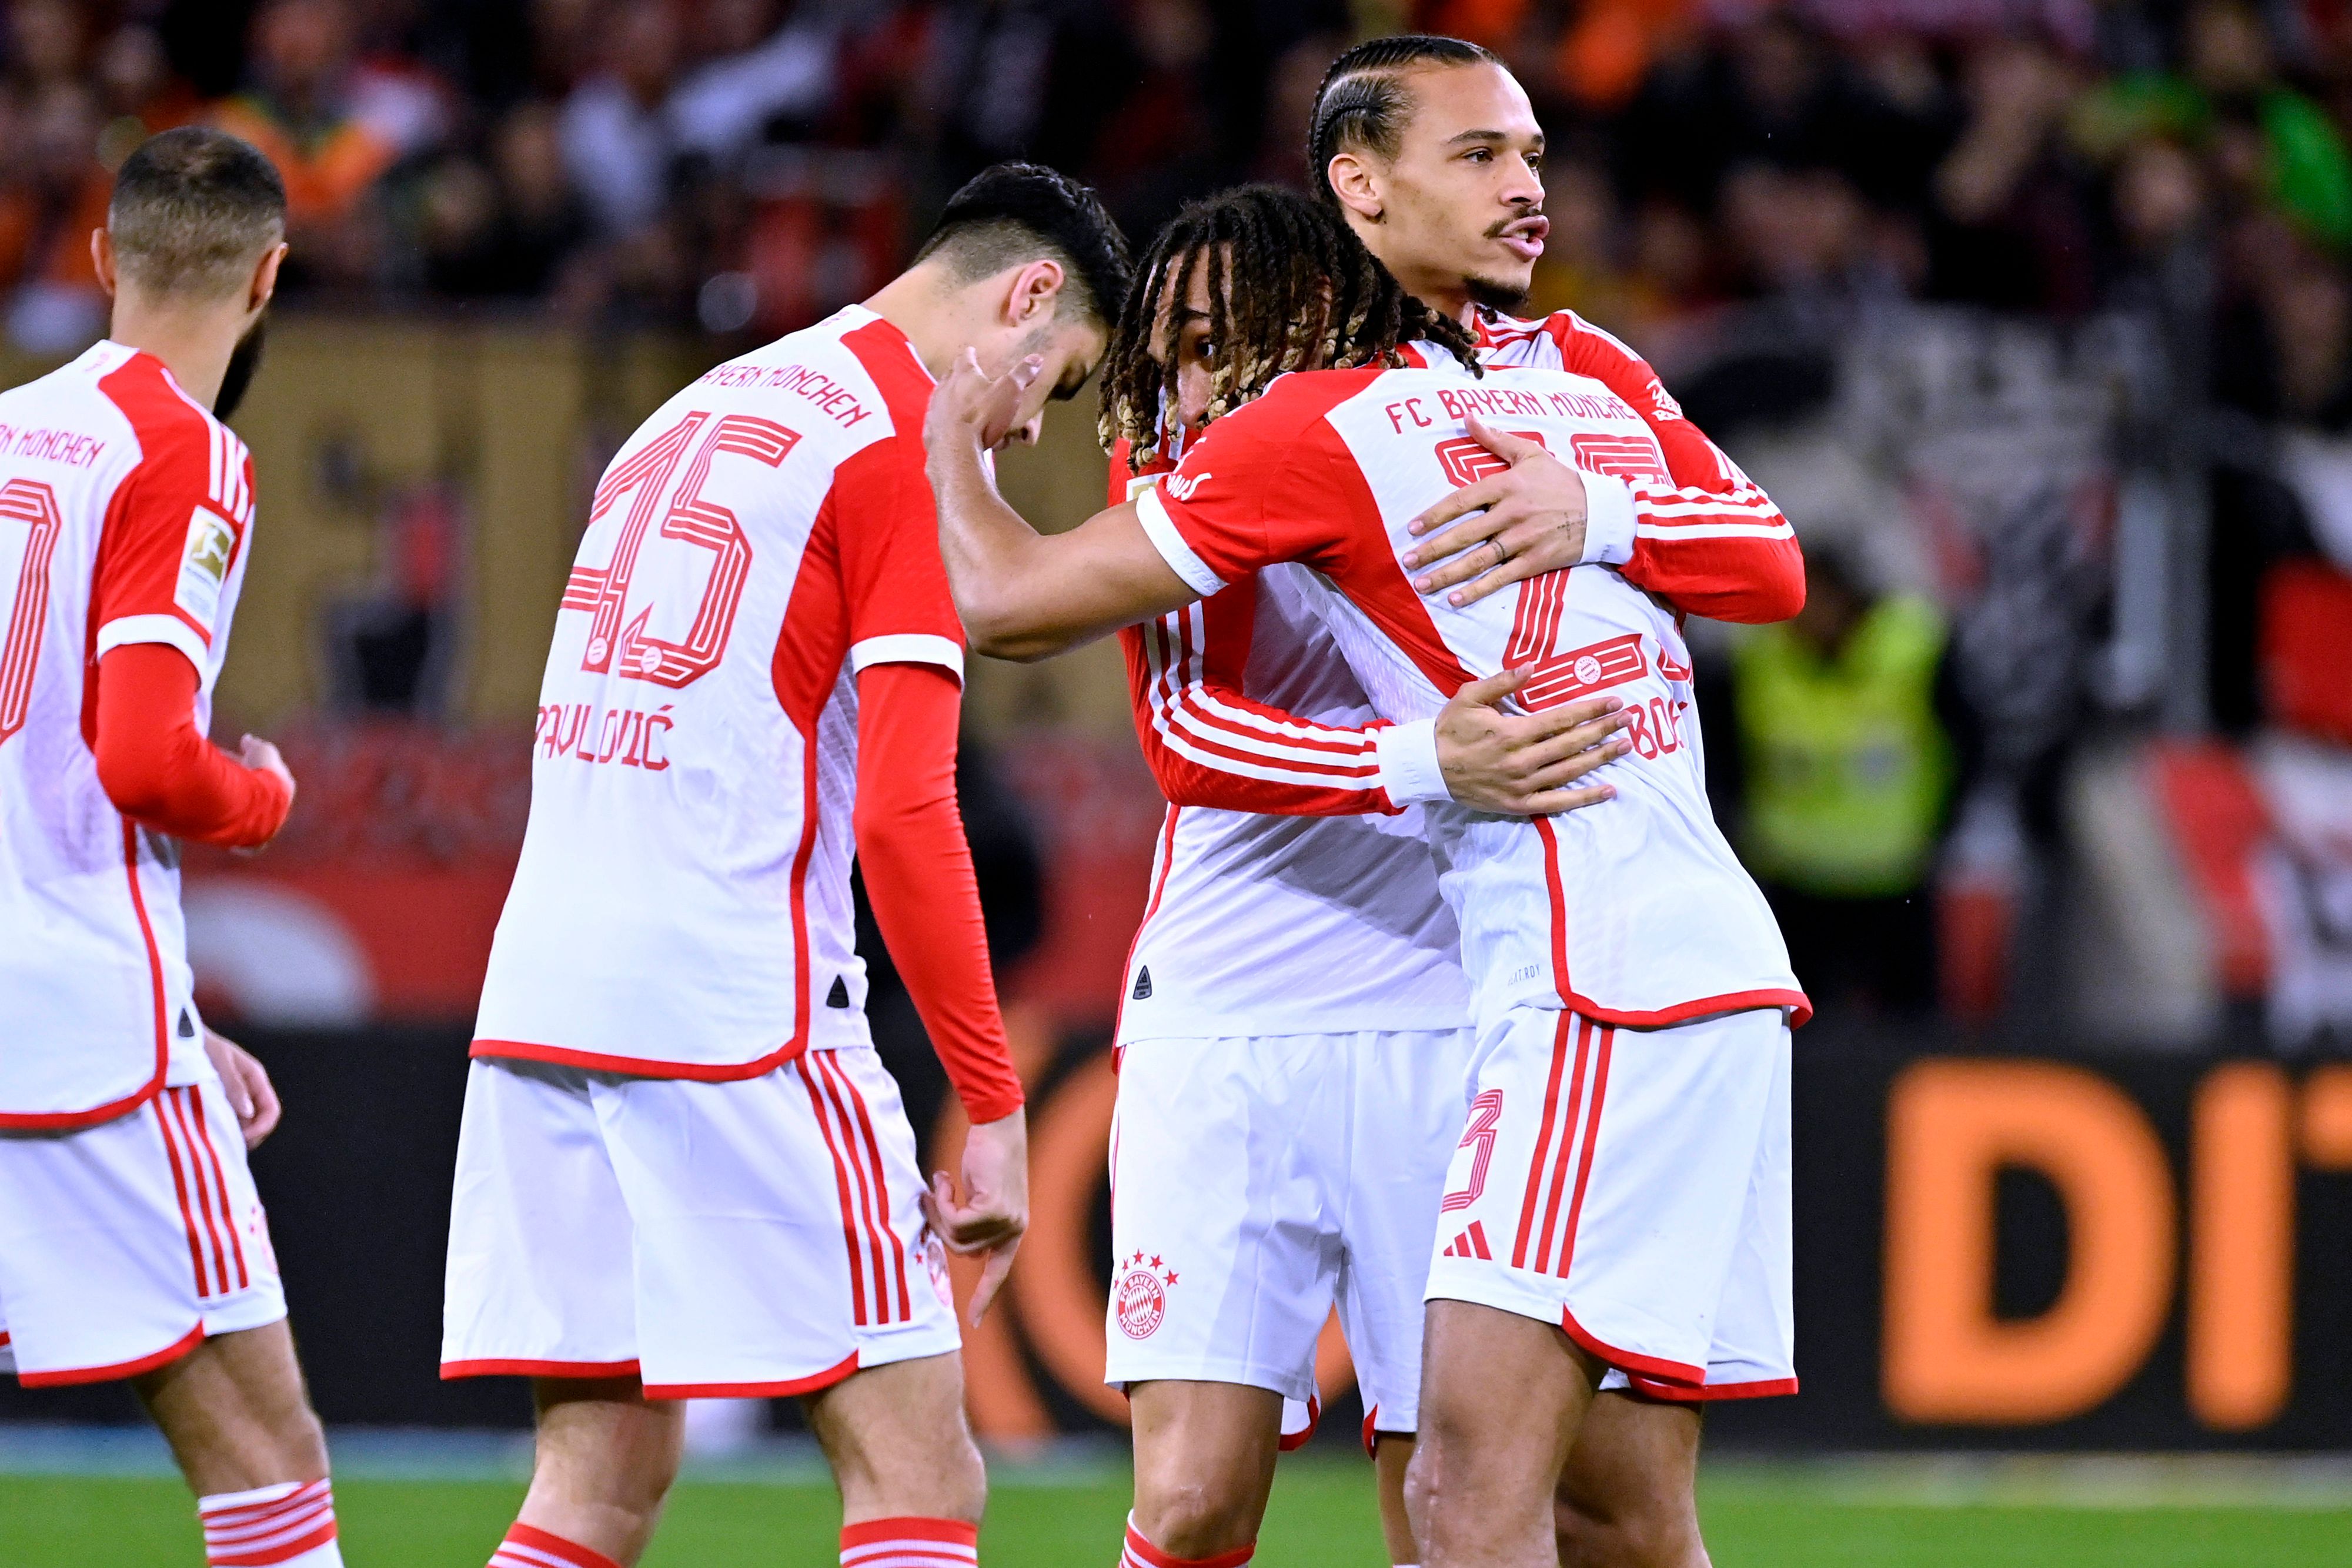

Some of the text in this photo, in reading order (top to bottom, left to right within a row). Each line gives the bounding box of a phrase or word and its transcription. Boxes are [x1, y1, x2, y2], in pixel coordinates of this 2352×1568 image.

[697, 365, 771, 387] AYERN
[1385, 397, 1432, 434] FC
[1436, 389, 1548, 421] BAYERN
[1542, 393, 1642, 421] MÜNCHE
[560, 410, 804, 690] 45
[534, 704, 674, 771] PAVLOVIĆ
[1128, 1274, 1161, 1299] BAYERN
